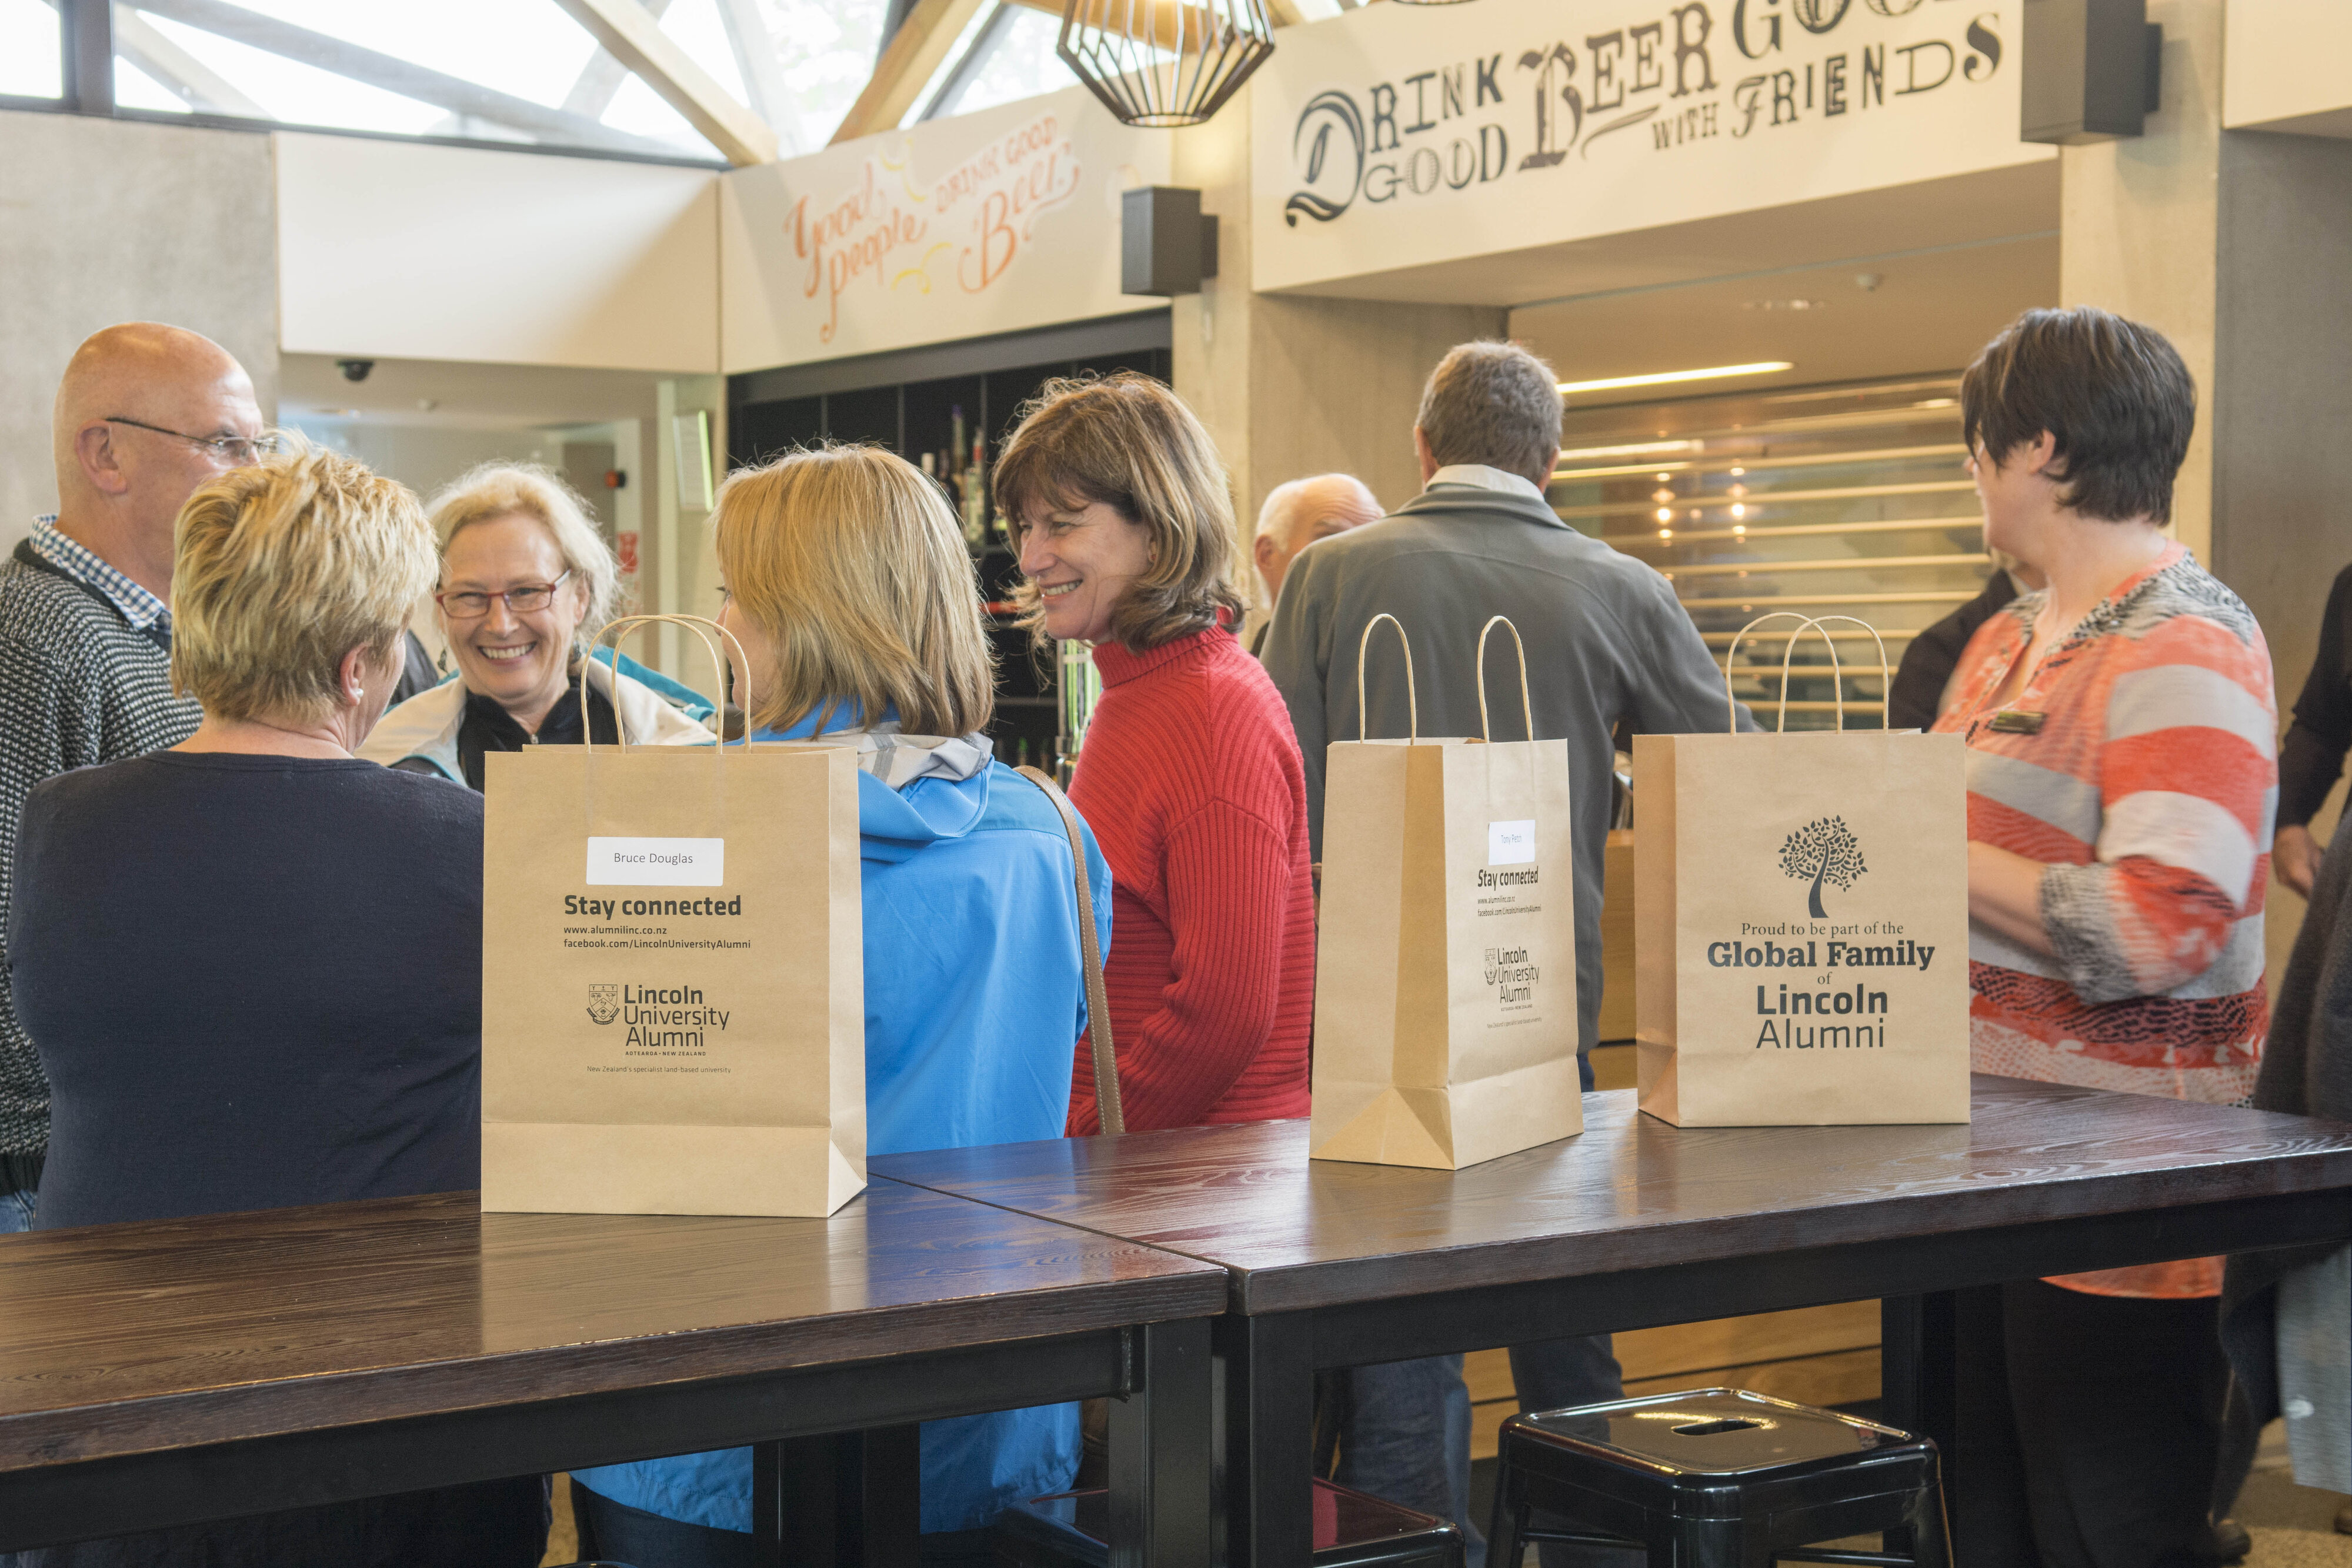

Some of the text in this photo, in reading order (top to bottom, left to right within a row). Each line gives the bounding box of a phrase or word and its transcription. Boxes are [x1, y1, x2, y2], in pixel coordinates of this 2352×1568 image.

[1652, 13, 2003, 151] WITH FRIENDS
[1006, 116, 1057, 165] GOOD
[1286, 52, 1503, 227] DRINK
[1363, 124, 1509, 203] GOOD
[820, 207, 927, 343] people
[1501, 835, 1511, 845] Tony
[614, 853, 693, 866] Bruce Douglas
[1477, 866, 1539, 891] Stay connected
[565, 895, 741, 920] Stay connected
[564, 926, 667, 934] www.alumnilinc.co.nz
[1742, 922, 1904, 939] Proud to be part of the
[564, 939, 750, 950] facebook.com/LincolnUniversityAlumni
[1497, 946, 1528, 965] Lincoln
[1707, 940, 1936, 971] Global Family
[1498, 964, 1539, 984] University
[1817, 972, 1833, 985] of
[625, 985, 703, 1004] Lincoln
[1500, 982, 1530, 1003] Alumni
[1757, 983, 1888, 1015] Lincoln
[625, 1005, 730, 1030] University
[626, 1026, 703, 1046] Alumni
[1756, 1017, 1884, 1049] Alumni
